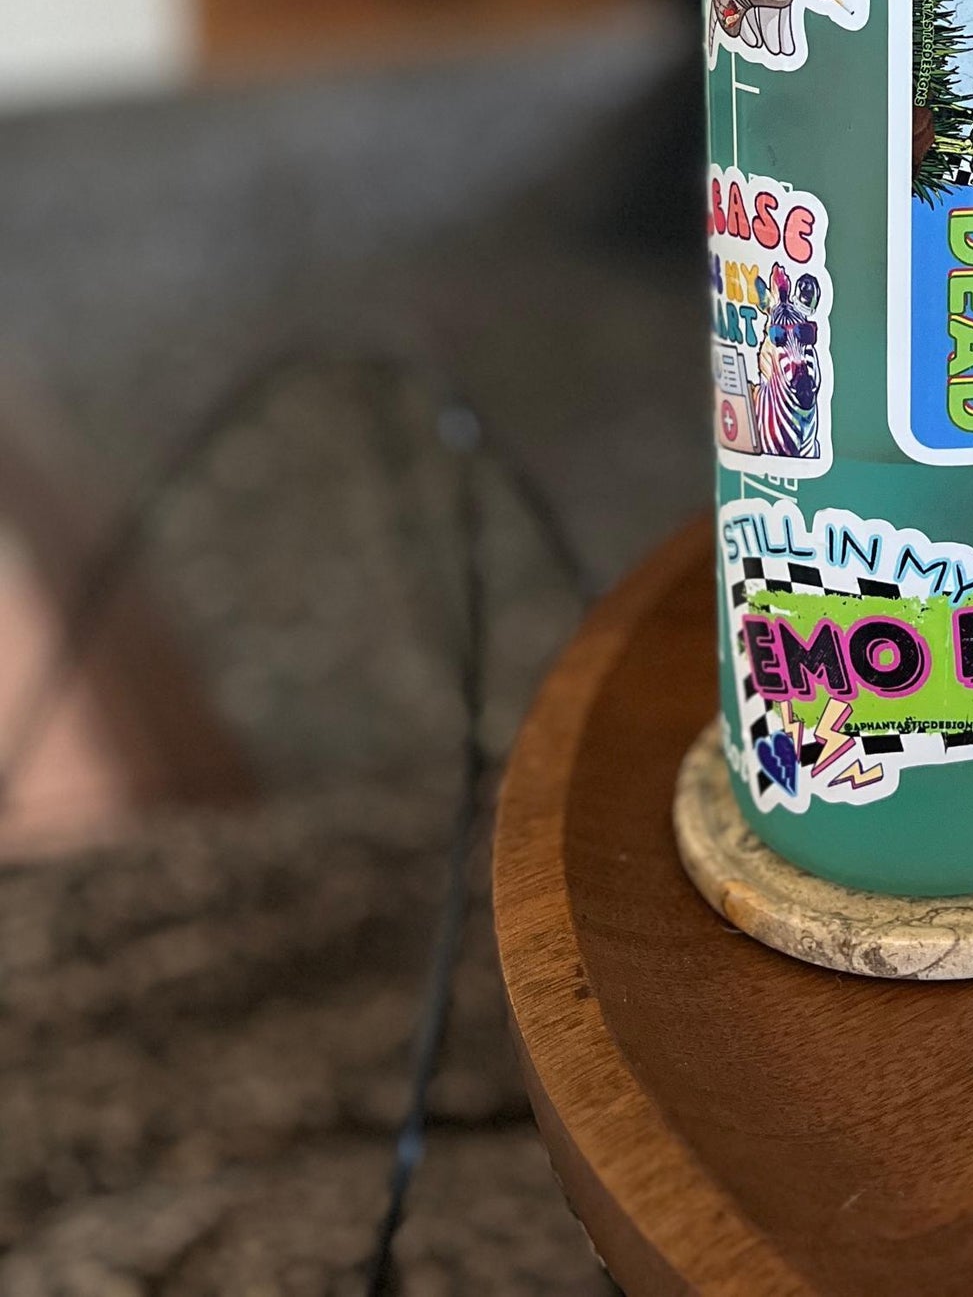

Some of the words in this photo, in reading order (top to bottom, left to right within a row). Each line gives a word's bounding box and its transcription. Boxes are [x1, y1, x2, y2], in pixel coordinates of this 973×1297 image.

[707, 177, 816, 264] EASE
[723, 512, 816, 564] STILL
[826, 523, 880, 575] IN
[744, 615, 931, 700] EMO
